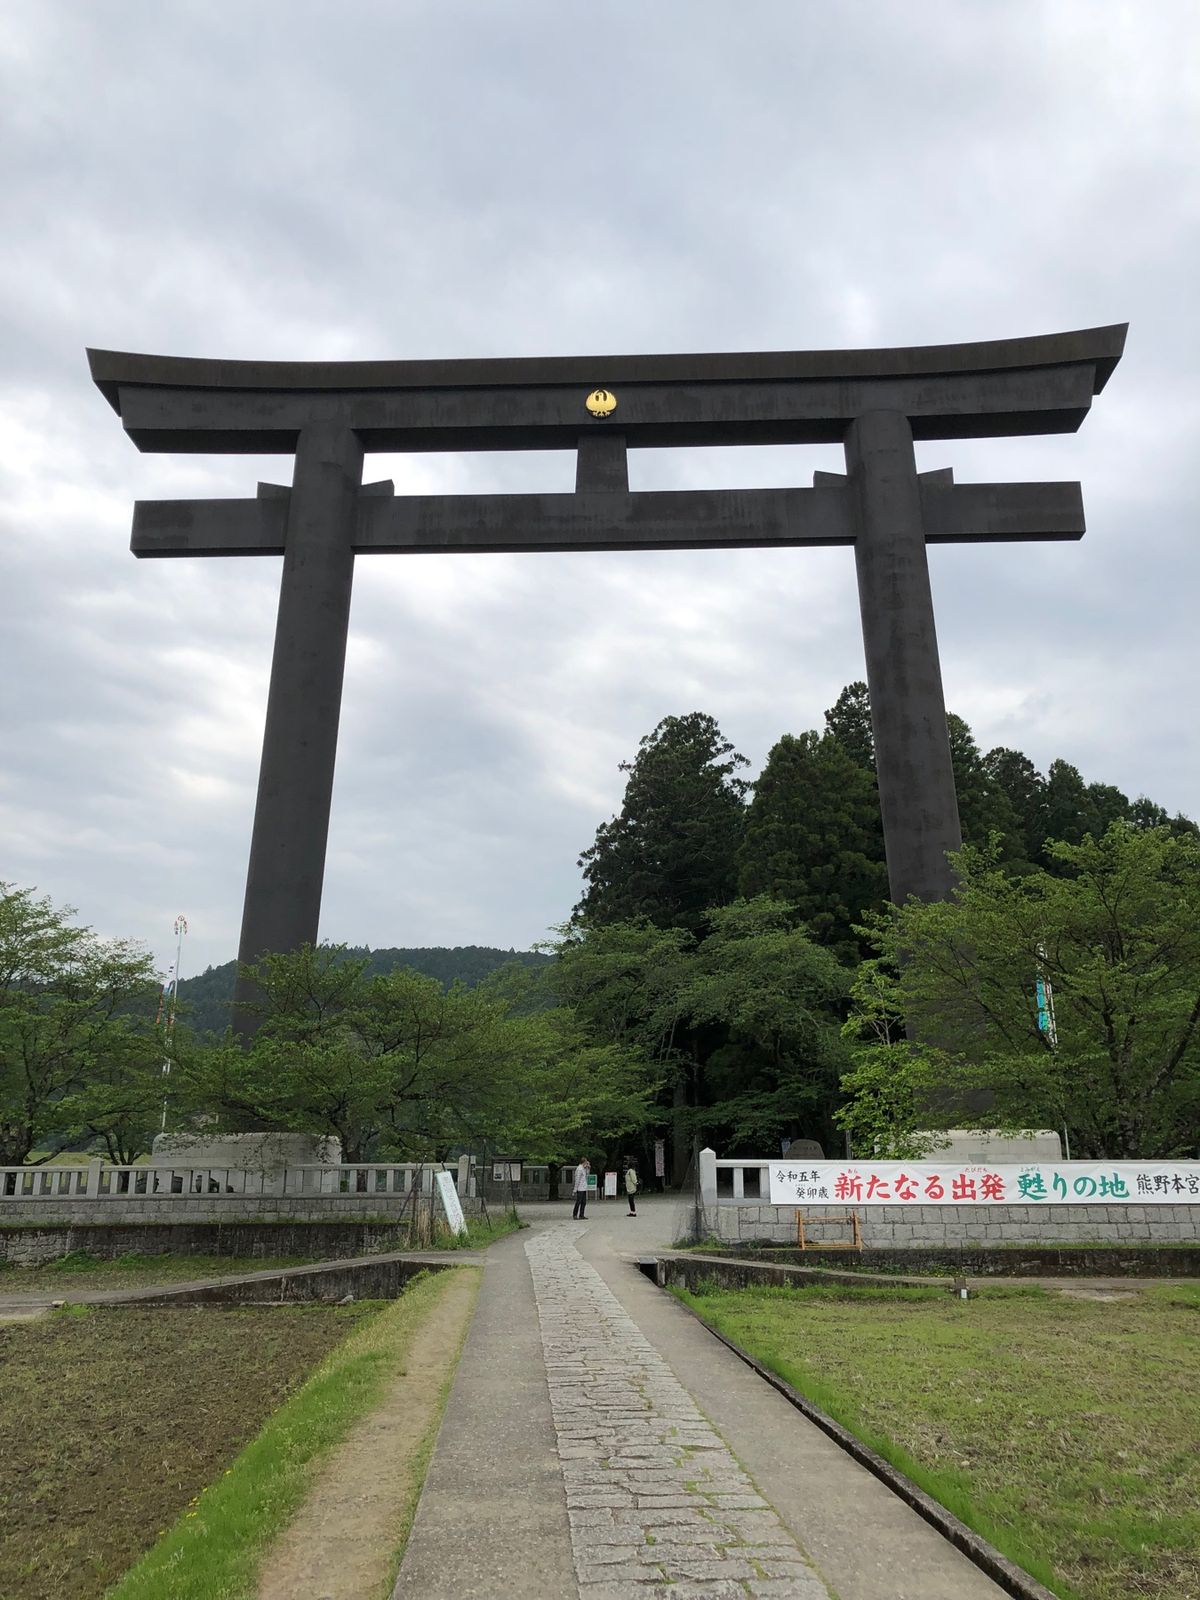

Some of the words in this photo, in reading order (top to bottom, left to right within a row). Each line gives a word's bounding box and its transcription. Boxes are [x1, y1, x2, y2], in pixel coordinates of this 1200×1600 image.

[776, 1170, 821, 1182] 令和五年
[1017, 1172, 1130, 1200] 甦りの地
[1136, 1174, 1200, 1195] 熊野本宮
[796, 1187, 829, 1199] 癸卯歳
